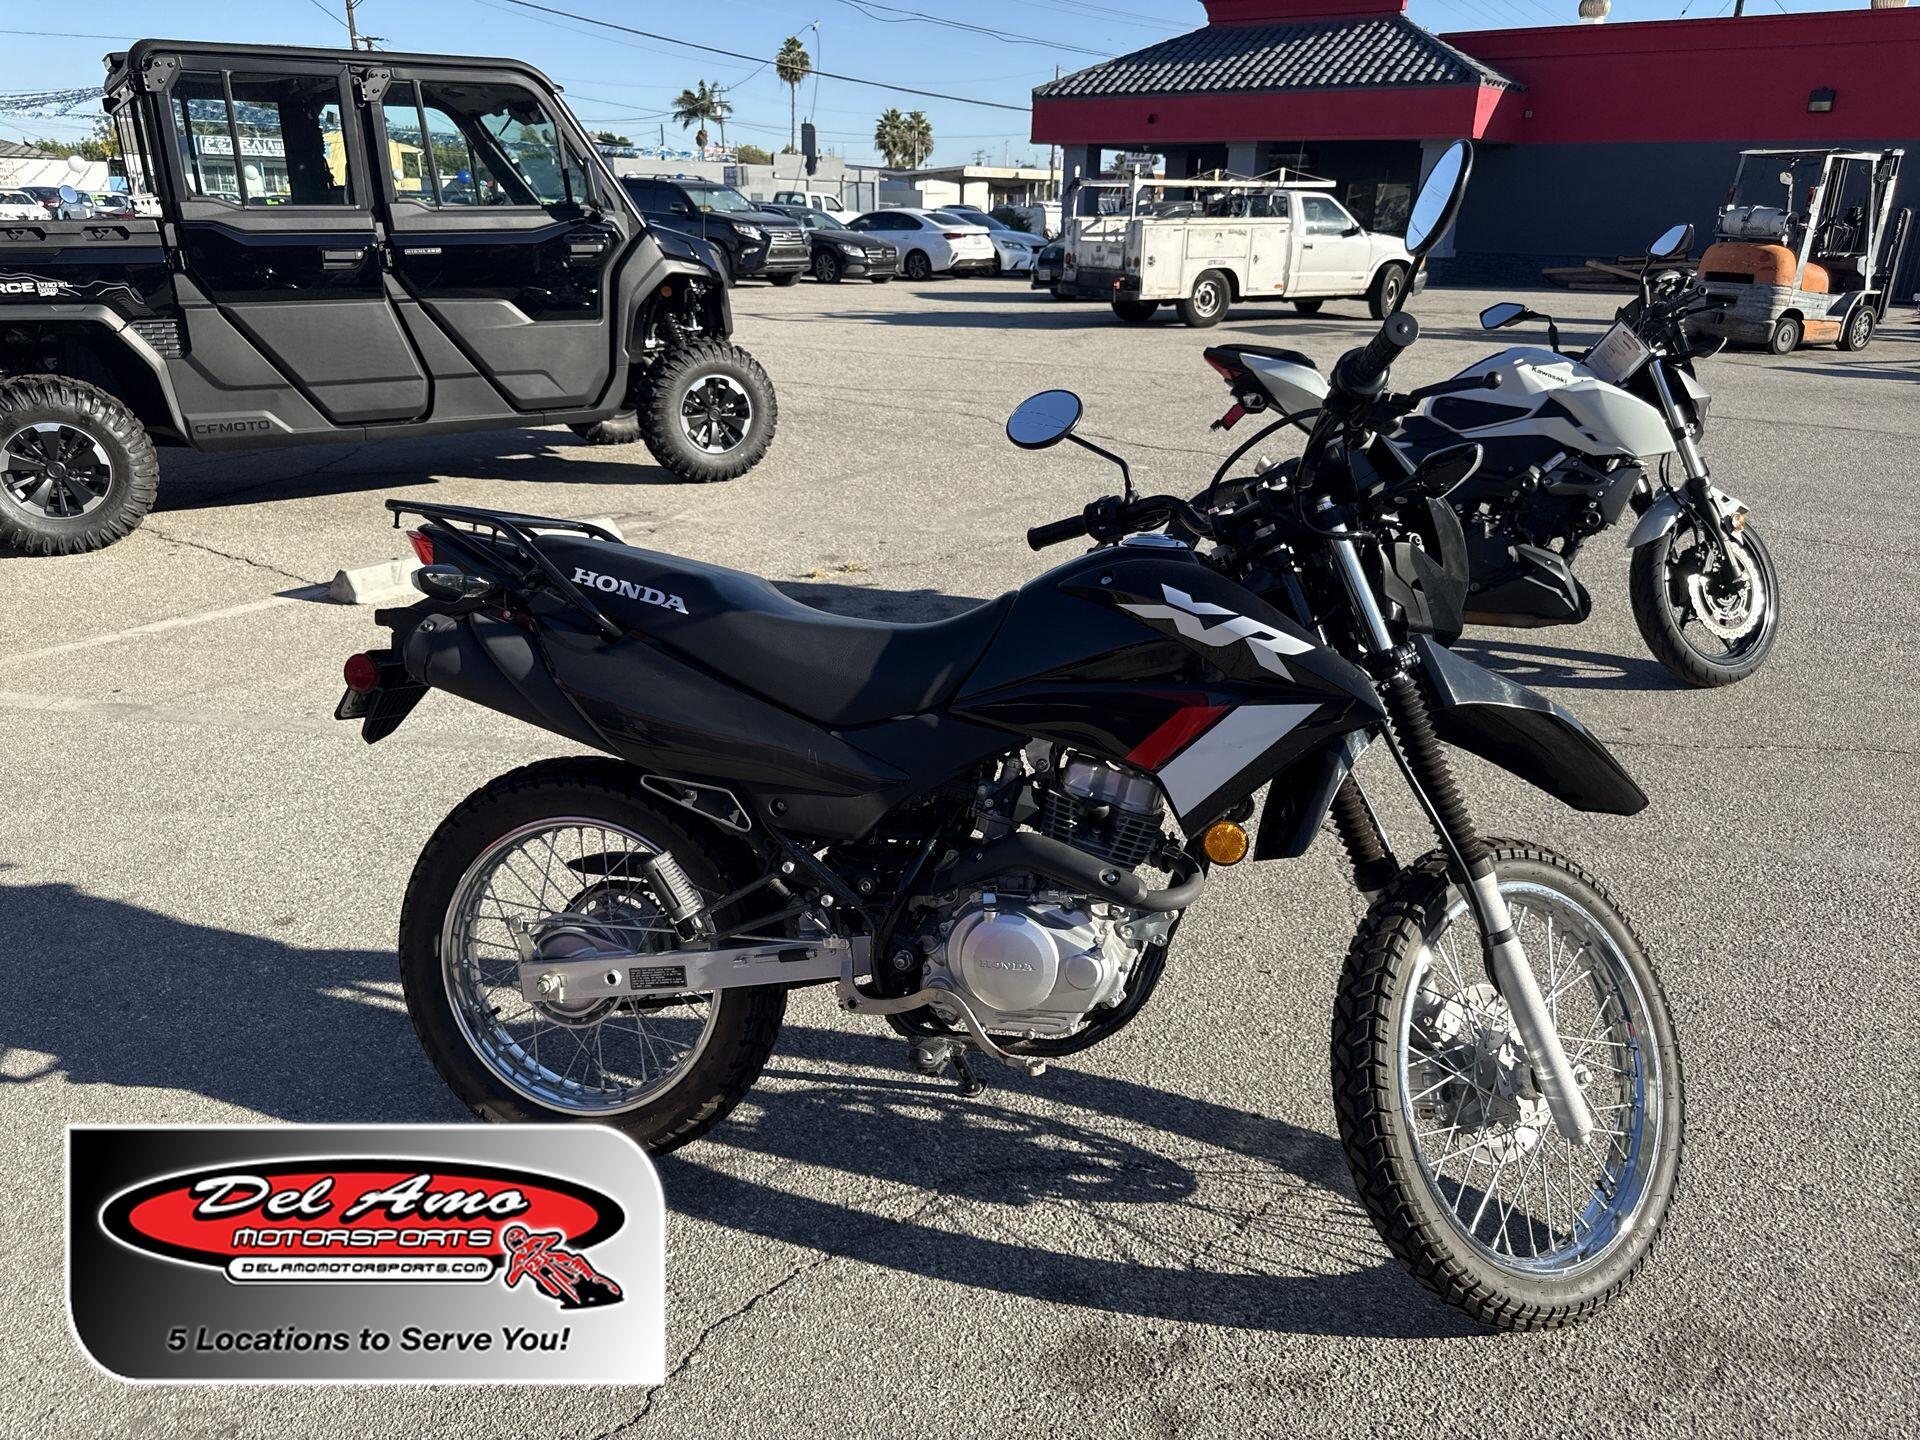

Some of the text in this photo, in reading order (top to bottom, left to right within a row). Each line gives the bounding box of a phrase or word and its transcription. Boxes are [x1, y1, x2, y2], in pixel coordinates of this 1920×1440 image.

[1531, 365, 1568, 385] Kawasaki
[195, 420, 270, 434] CFMOTO
[571, 567, 689, 615] HONDA
[979, 960, 1036, 971] HONDA
